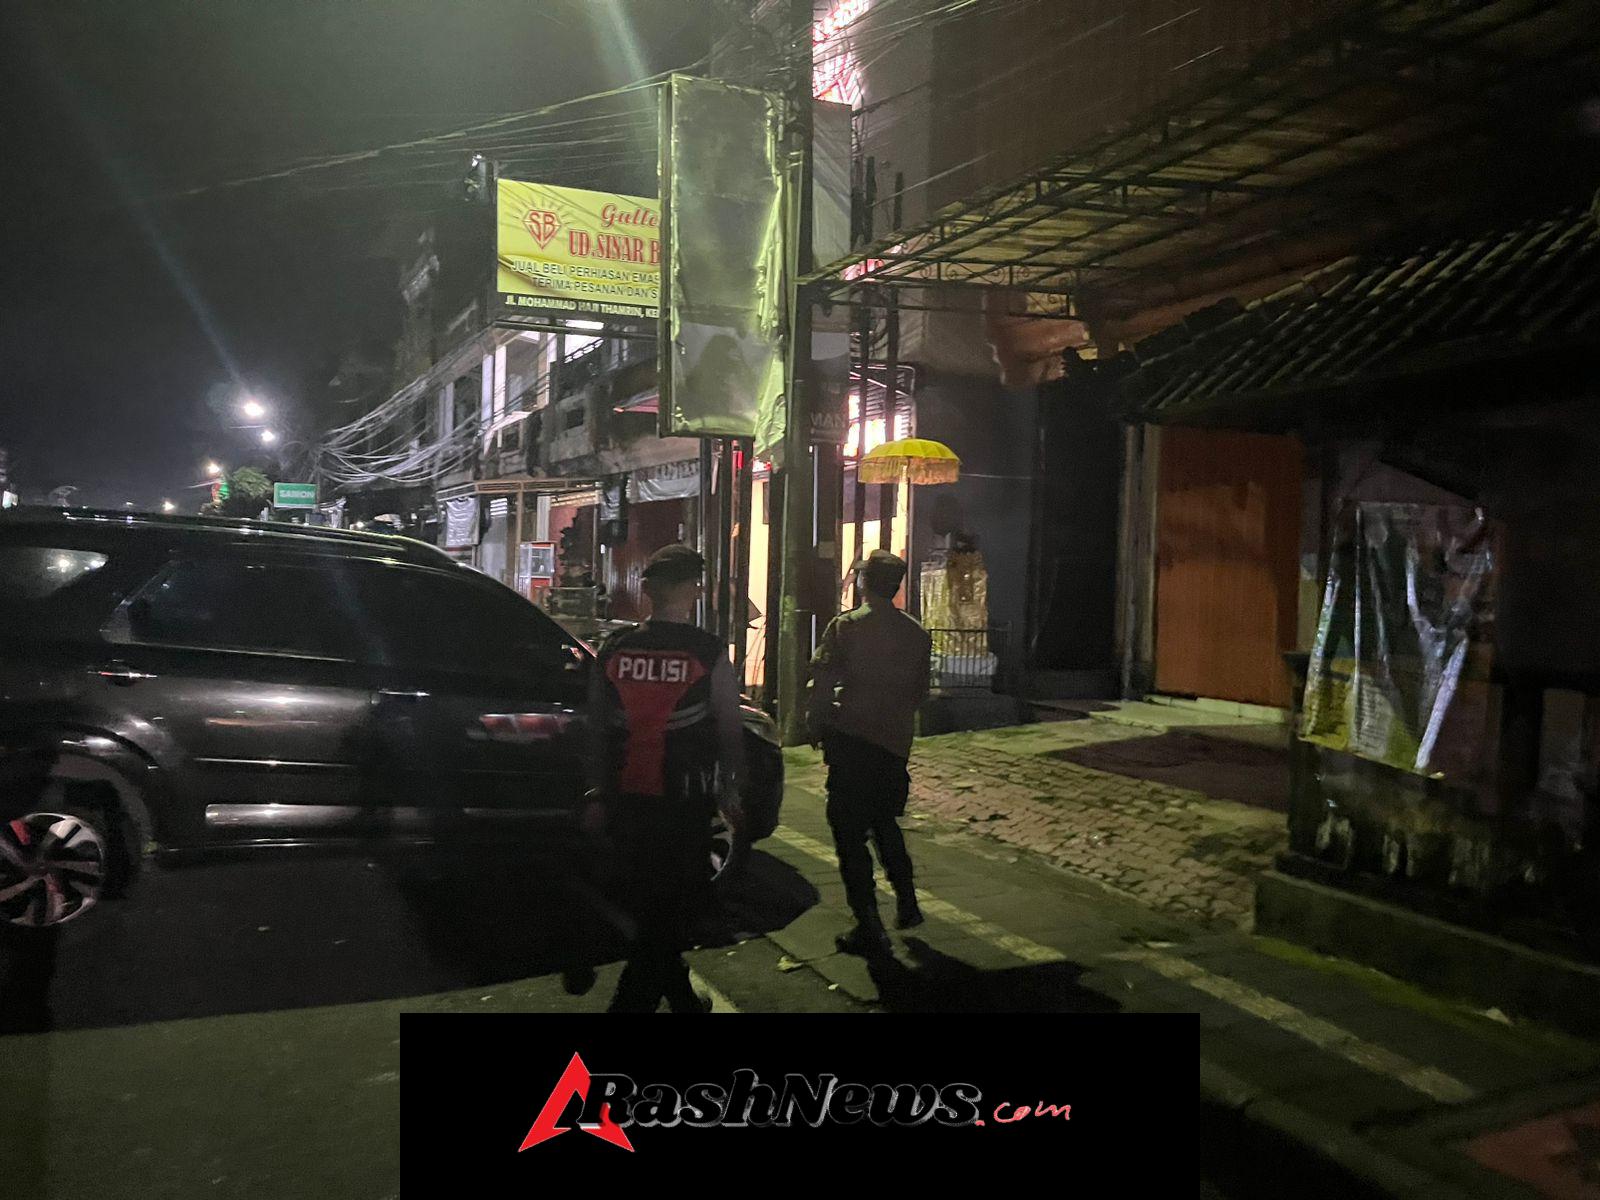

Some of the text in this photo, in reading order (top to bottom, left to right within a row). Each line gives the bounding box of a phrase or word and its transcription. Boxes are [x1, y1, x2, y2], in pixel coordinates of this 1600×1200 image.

[529, 211, 555, 241] SB
[512, 260, 540, 274] JUAL
[543, 263, 566, 276] BELI
[570, 266, 629, 282] PERHIASAN
[532, 277, 571, 290] TERIMA
[575, 281, 624, 296] PESANAN
[627, 286, 648, 298] DAN
[518, 295, 577, 311] MOHAMMAD
[578, 302, 599, 312] HAJI
[618, 656, 690, 683] POLISI
